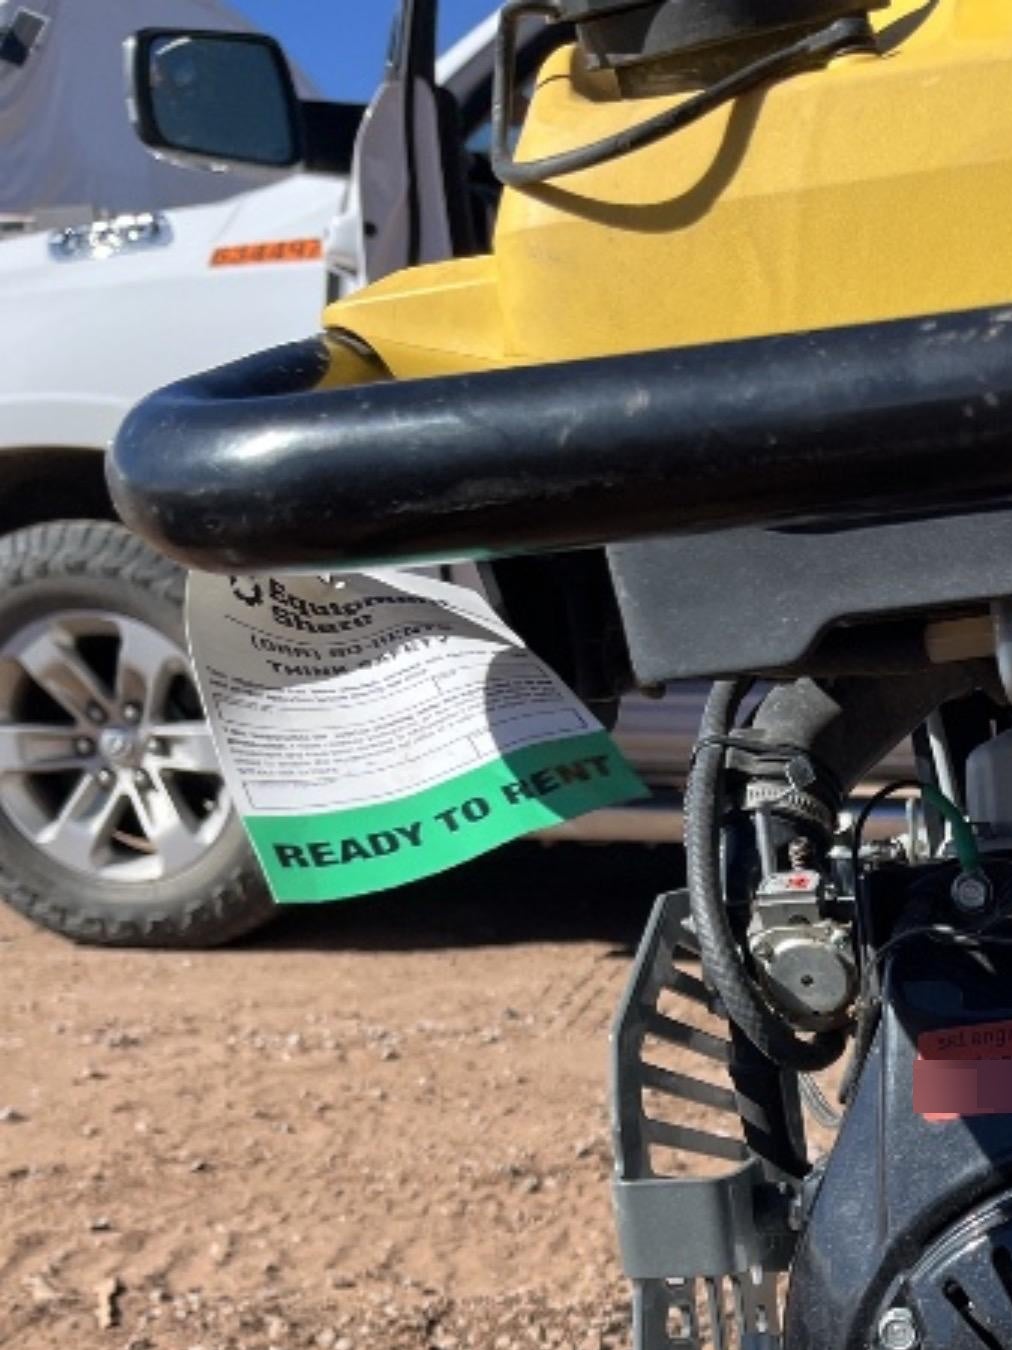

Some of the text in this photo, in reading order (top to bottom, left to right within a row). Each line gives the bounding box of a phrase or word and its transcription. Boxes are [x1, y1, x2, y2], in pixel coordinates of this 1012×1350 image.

[272, 755, 610, 868] READY TO RENT
